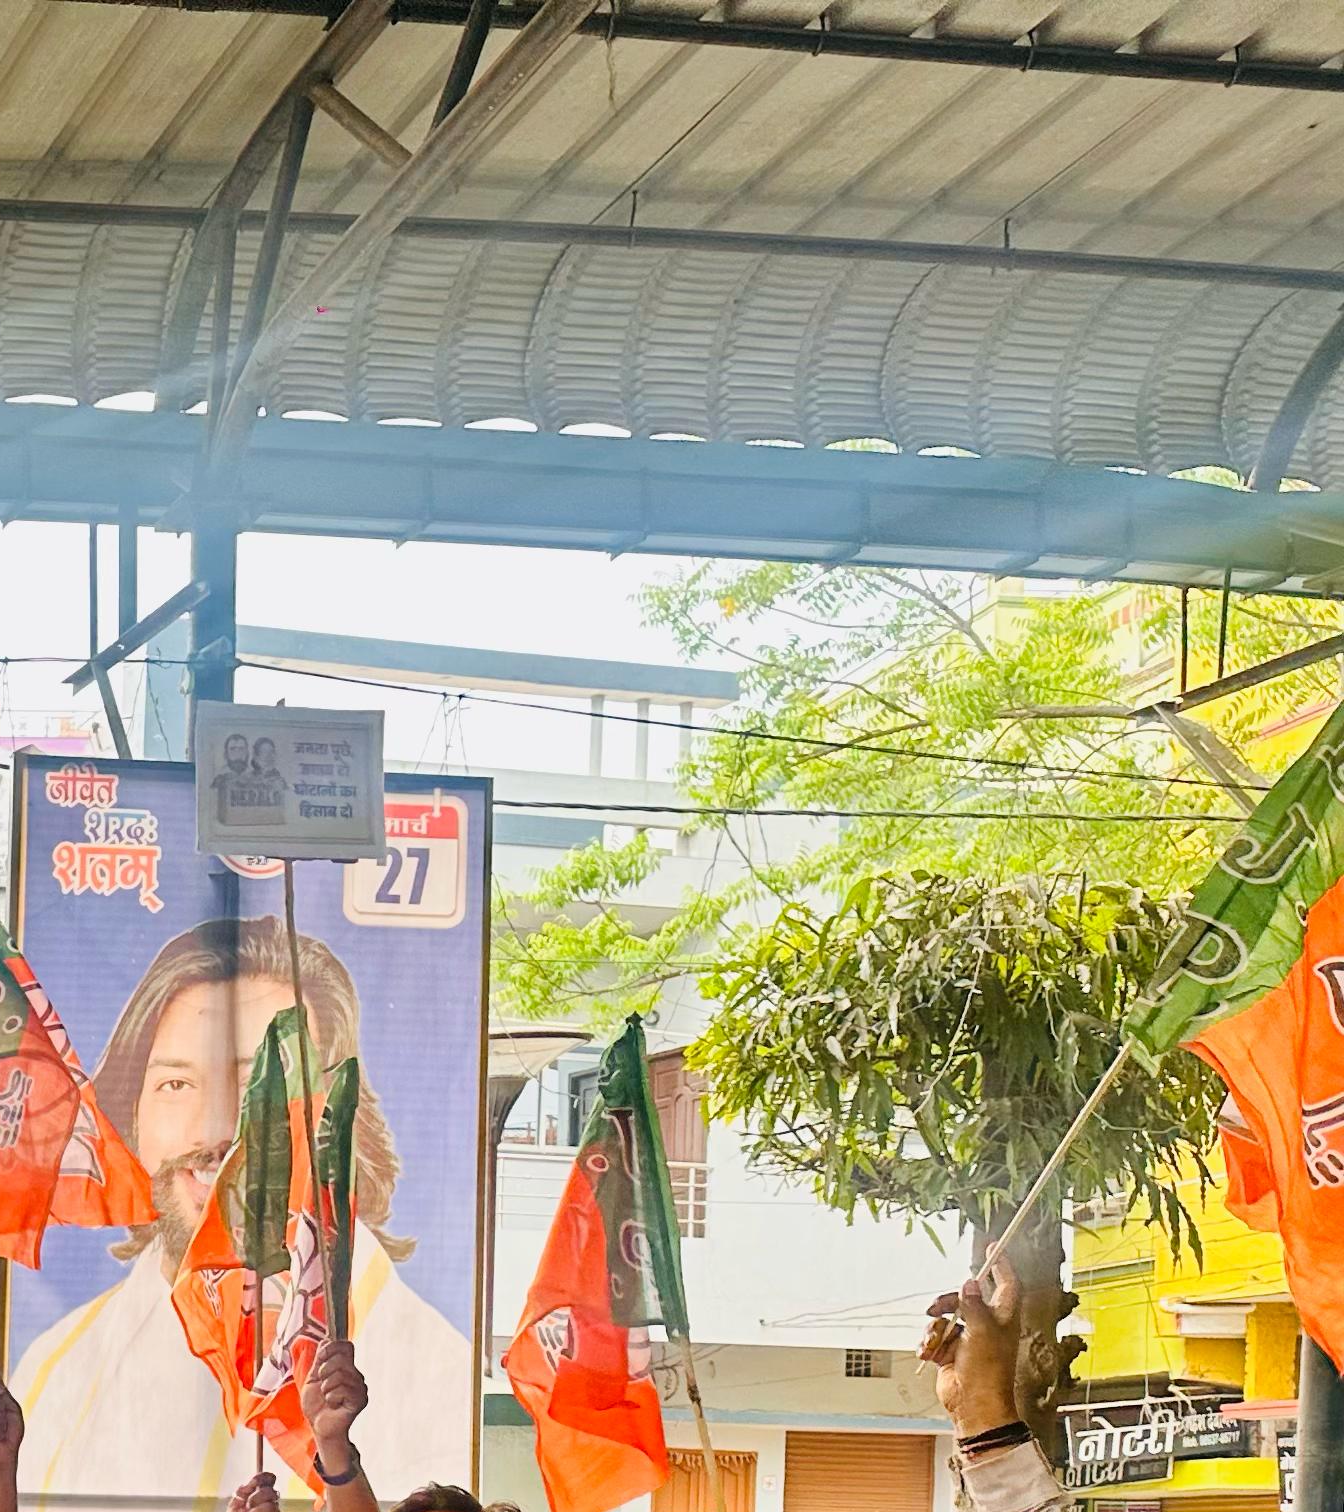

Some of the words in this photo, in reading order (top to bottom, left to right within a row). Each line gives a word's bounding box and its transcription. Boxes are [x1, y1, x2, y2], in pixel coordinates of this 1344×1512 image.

[293, 741, 327, 755] जनता
[336, 763, 351, 777] दो
[341, 785, 357, 798] का
[299, 800, 338, 818] हिसाब
[339, 804, 353, 819] दो
[55, 844, 161, 910] शतम्
[374, 846, 430, 905] 27
[1076, 1408, 1179, 1463] नोटरी
